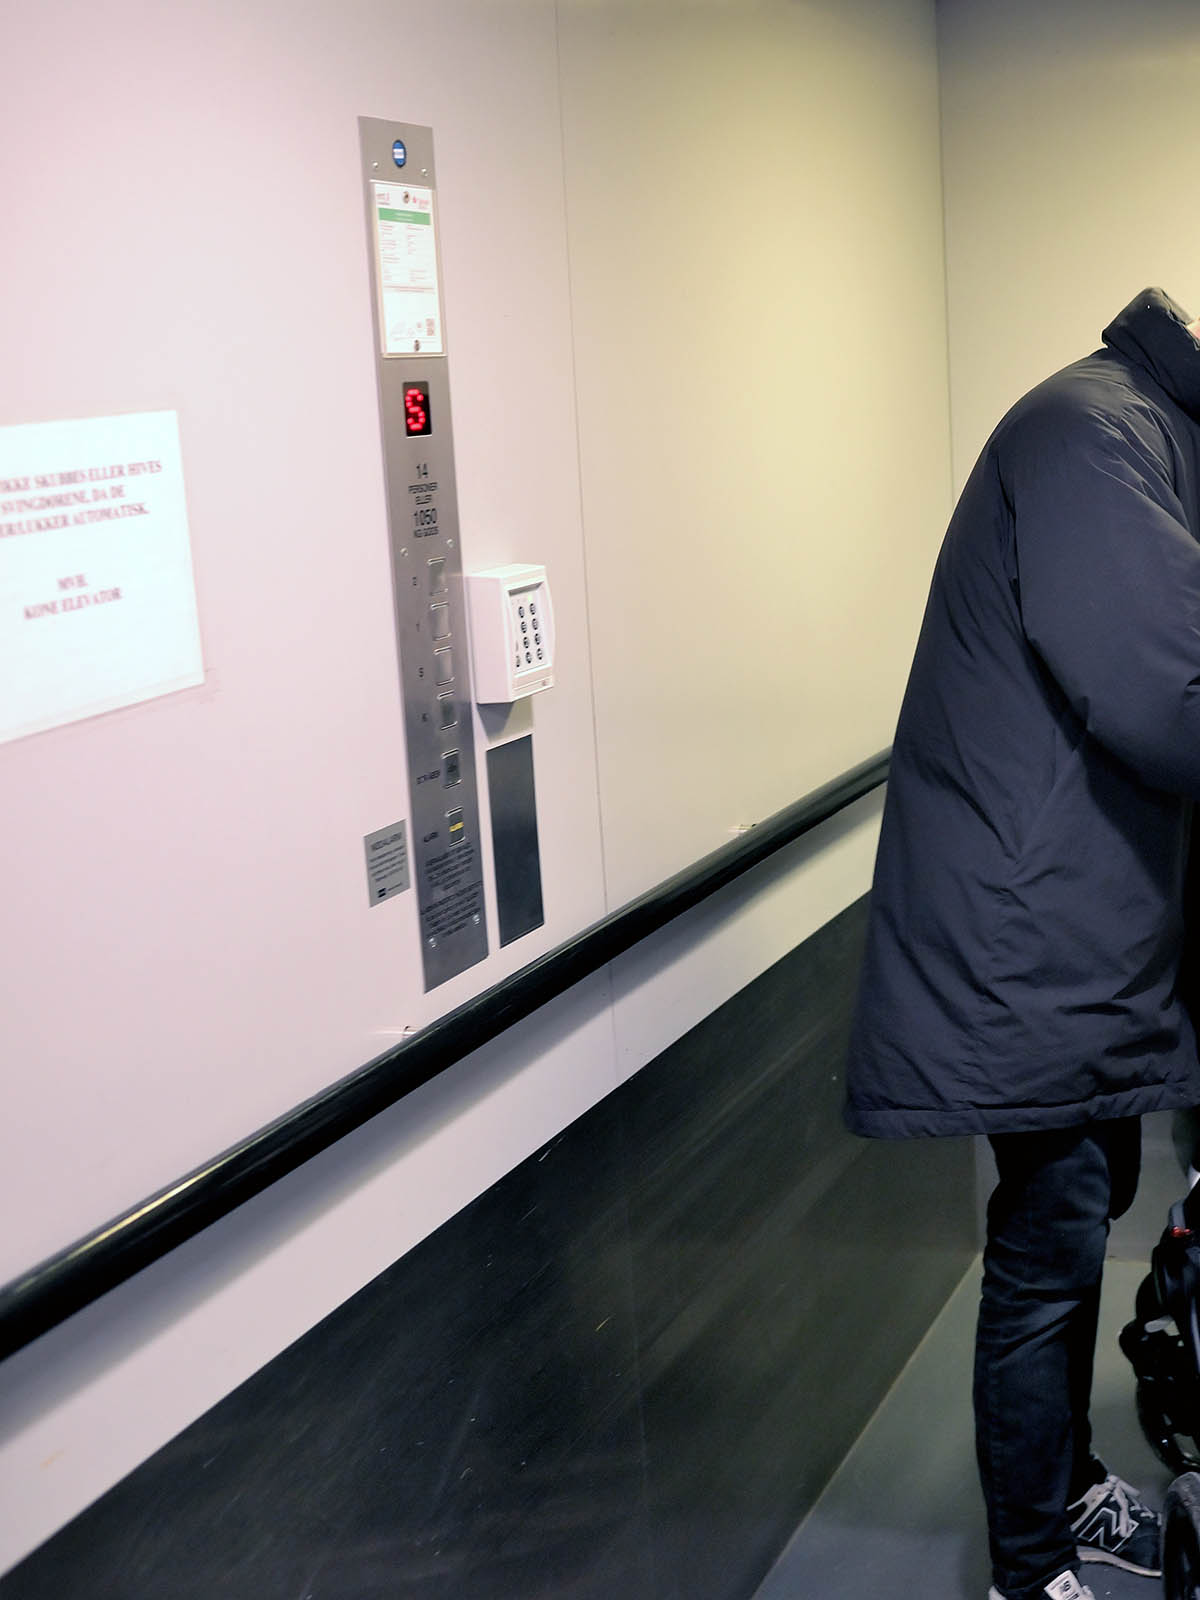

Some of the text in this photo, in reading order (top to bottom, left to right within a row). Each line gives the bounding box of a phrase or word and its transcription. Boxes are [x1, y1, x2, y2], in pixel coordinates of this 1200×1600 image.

[88, 465, 124, 482] ELLER
[416, 463, 429, 479] 14
[414, 508, 438, 527] 1050
